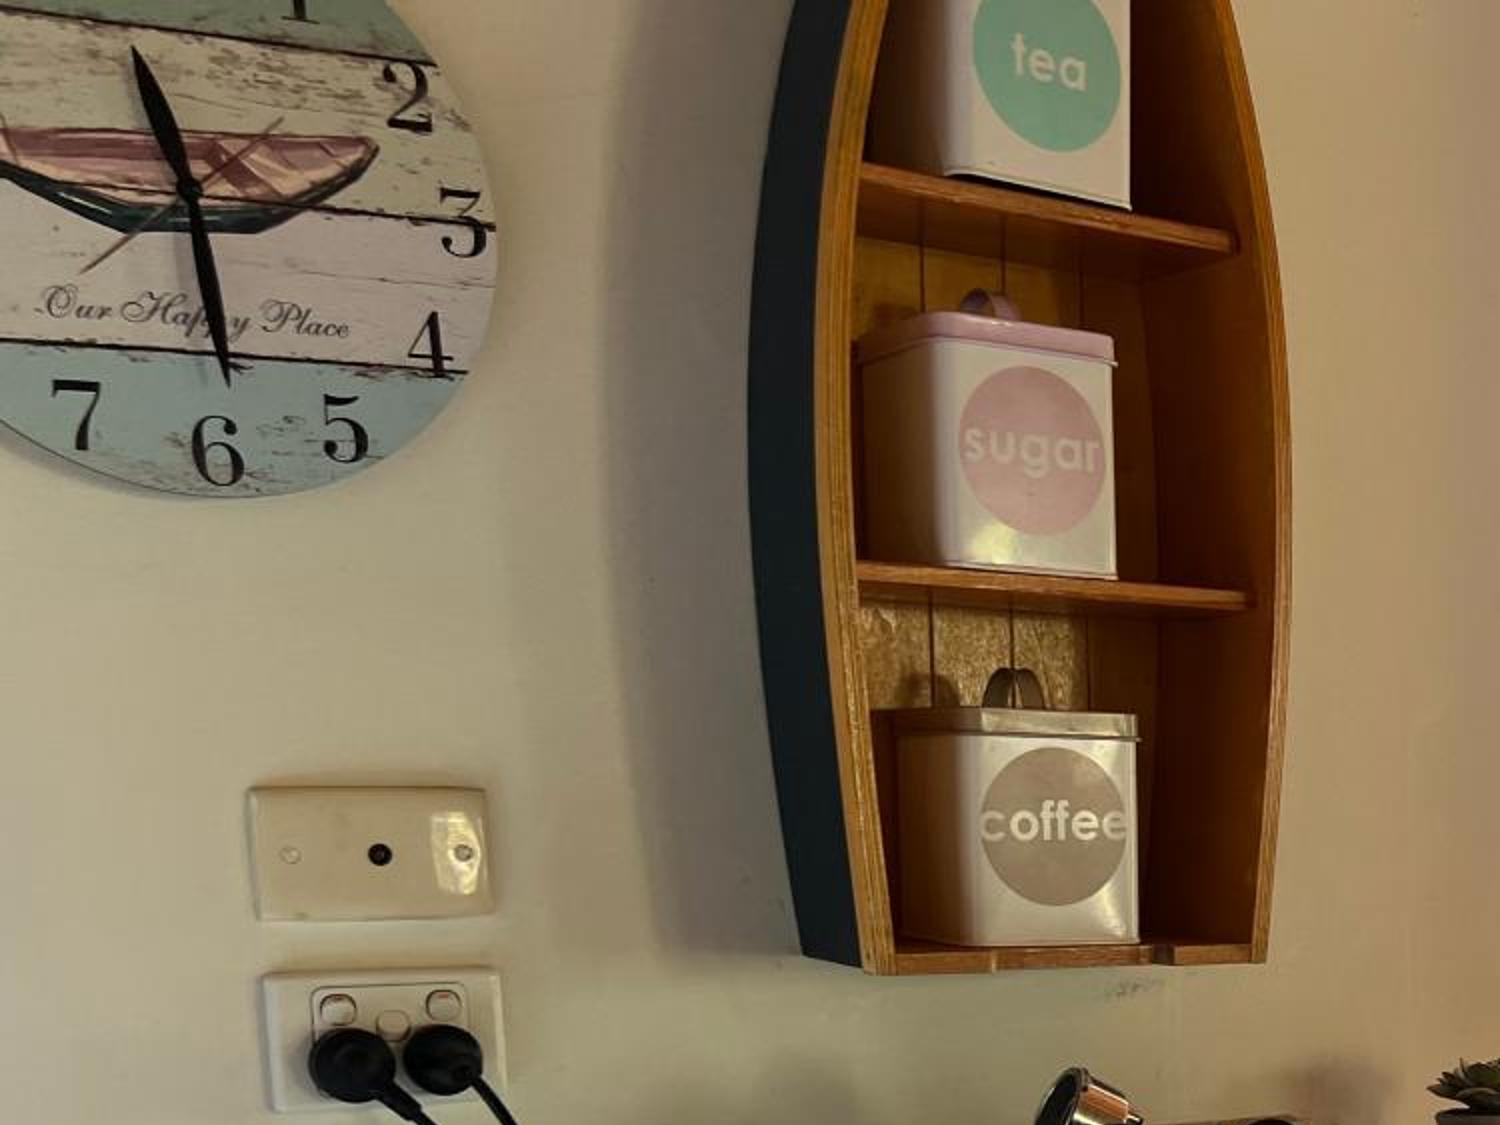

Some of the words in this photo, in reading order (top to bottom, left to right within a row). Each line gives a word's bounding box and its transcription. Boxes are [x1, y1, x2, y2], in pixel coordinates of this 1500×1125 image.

[1011, 33, 1088, 91] tea
[382, 62, 432, 133] 2
[440, 187, 487, 258] 3
[40, 284, 112, 318] Our
[120, 291, 251, 342] Hapy
[260, 298, 350, 338] Place
[408, 311, 454, 379] 4
[51, 380, 100, 450] 7
[322, 394, 369, 462] 5
[191, 415, 245, 486] 6
[964, 428, 1101, 479] sugar
[981, 799, 1127, 842] coffee
